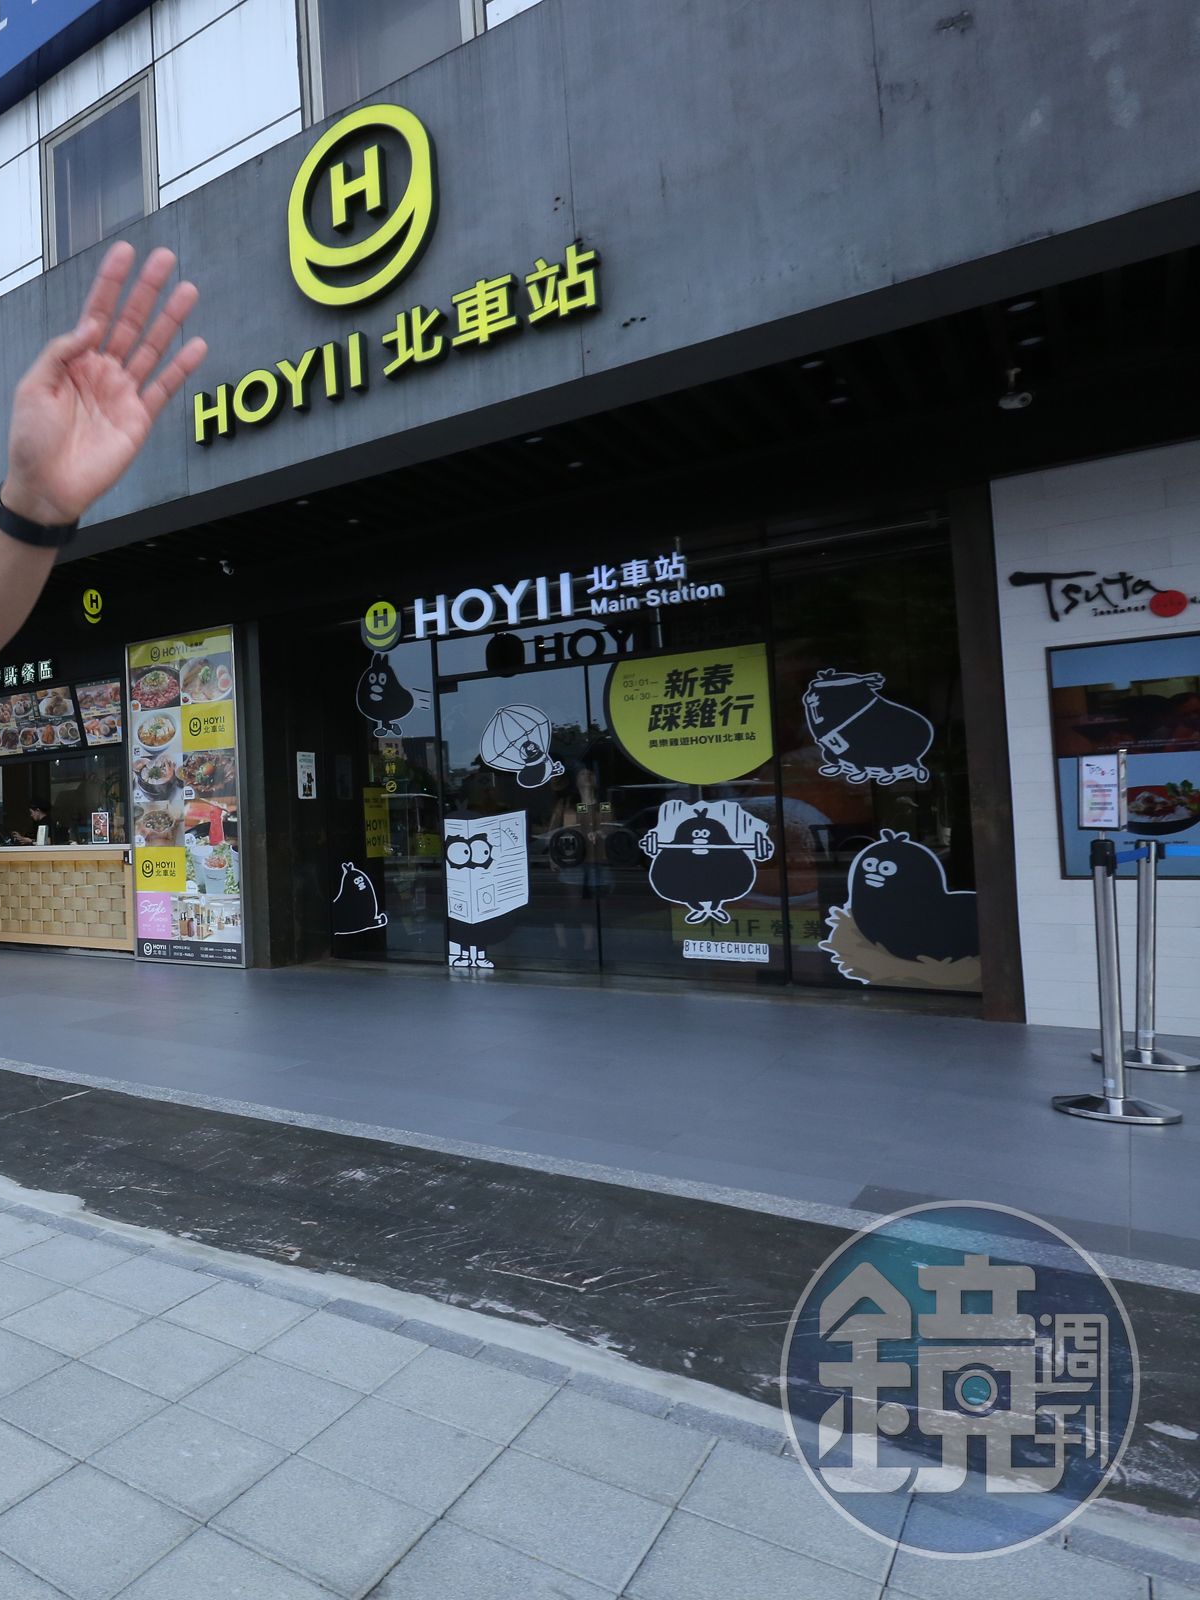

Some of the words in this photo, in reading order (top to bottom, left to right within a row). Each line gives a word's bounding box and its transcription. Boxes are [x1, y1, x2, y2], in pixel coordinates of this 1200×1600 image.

[329, 143, 384, 231] H
[193, 331, 366, 444] HOYII
[381, 243, 600, 378] 北車站
[586, 551, 687, 596] 北車站
[89, 592, 99, 610] H
[414, 571, 575, 639] HOYII
[590, 595, 640, 616] Main
[645, 581, 725, 608] Station
[1008, 570, 1169, 622] Tsuta
[373, 608, 389, 629] H
[663, 663, 734, 700] 新春
[647, 694, 755, 733] 踩雞行
[684, 940, 768, 955] BYEBYECHUCHU
